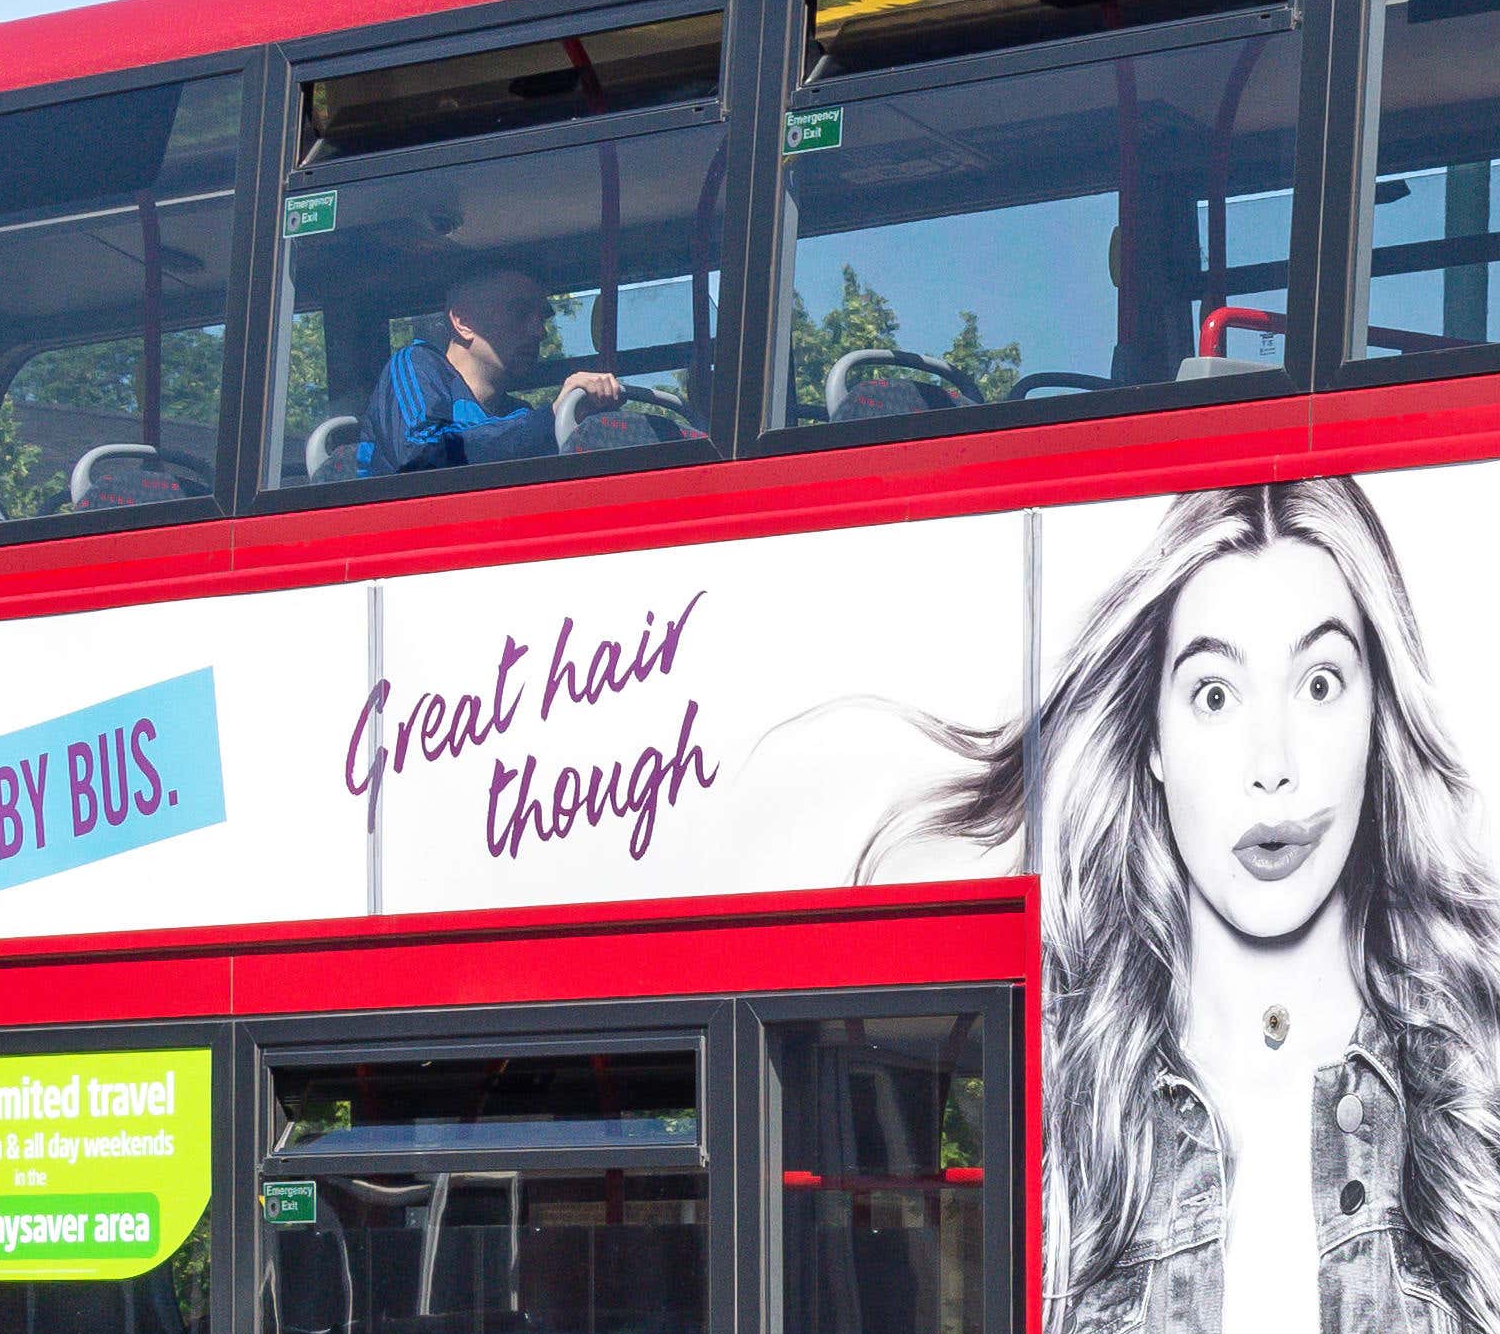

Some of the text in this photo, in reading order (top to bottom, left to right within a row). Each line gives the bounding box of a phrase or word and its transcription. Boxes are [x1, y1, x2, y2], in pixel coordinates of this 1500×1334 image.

[787, 110, 840, 126] Emergency
[803, 127, 821, 139] Exit
[286, 196, 335, 211] Emergency
[301, 212, 318, 224] Exit
[345, 590, 708, 834] Great hair
[68, 717, 179, 837] BUS.
[486, 700, 719, 860] though
[86, 1070, 176, 1118] travel
[5, 1132, 20, 1160] &
[23, 1131, 45, 1160] all
[48, 1131, 81, 1165] day
[83, 1128, 175, 1158] weekends
[13, 1168, 47, 1187] in the
[266, 1185, 313, 1198] Emergency
[281, 1200, 298, 1211] Exit
[93, 1212, 150, 1243] area
